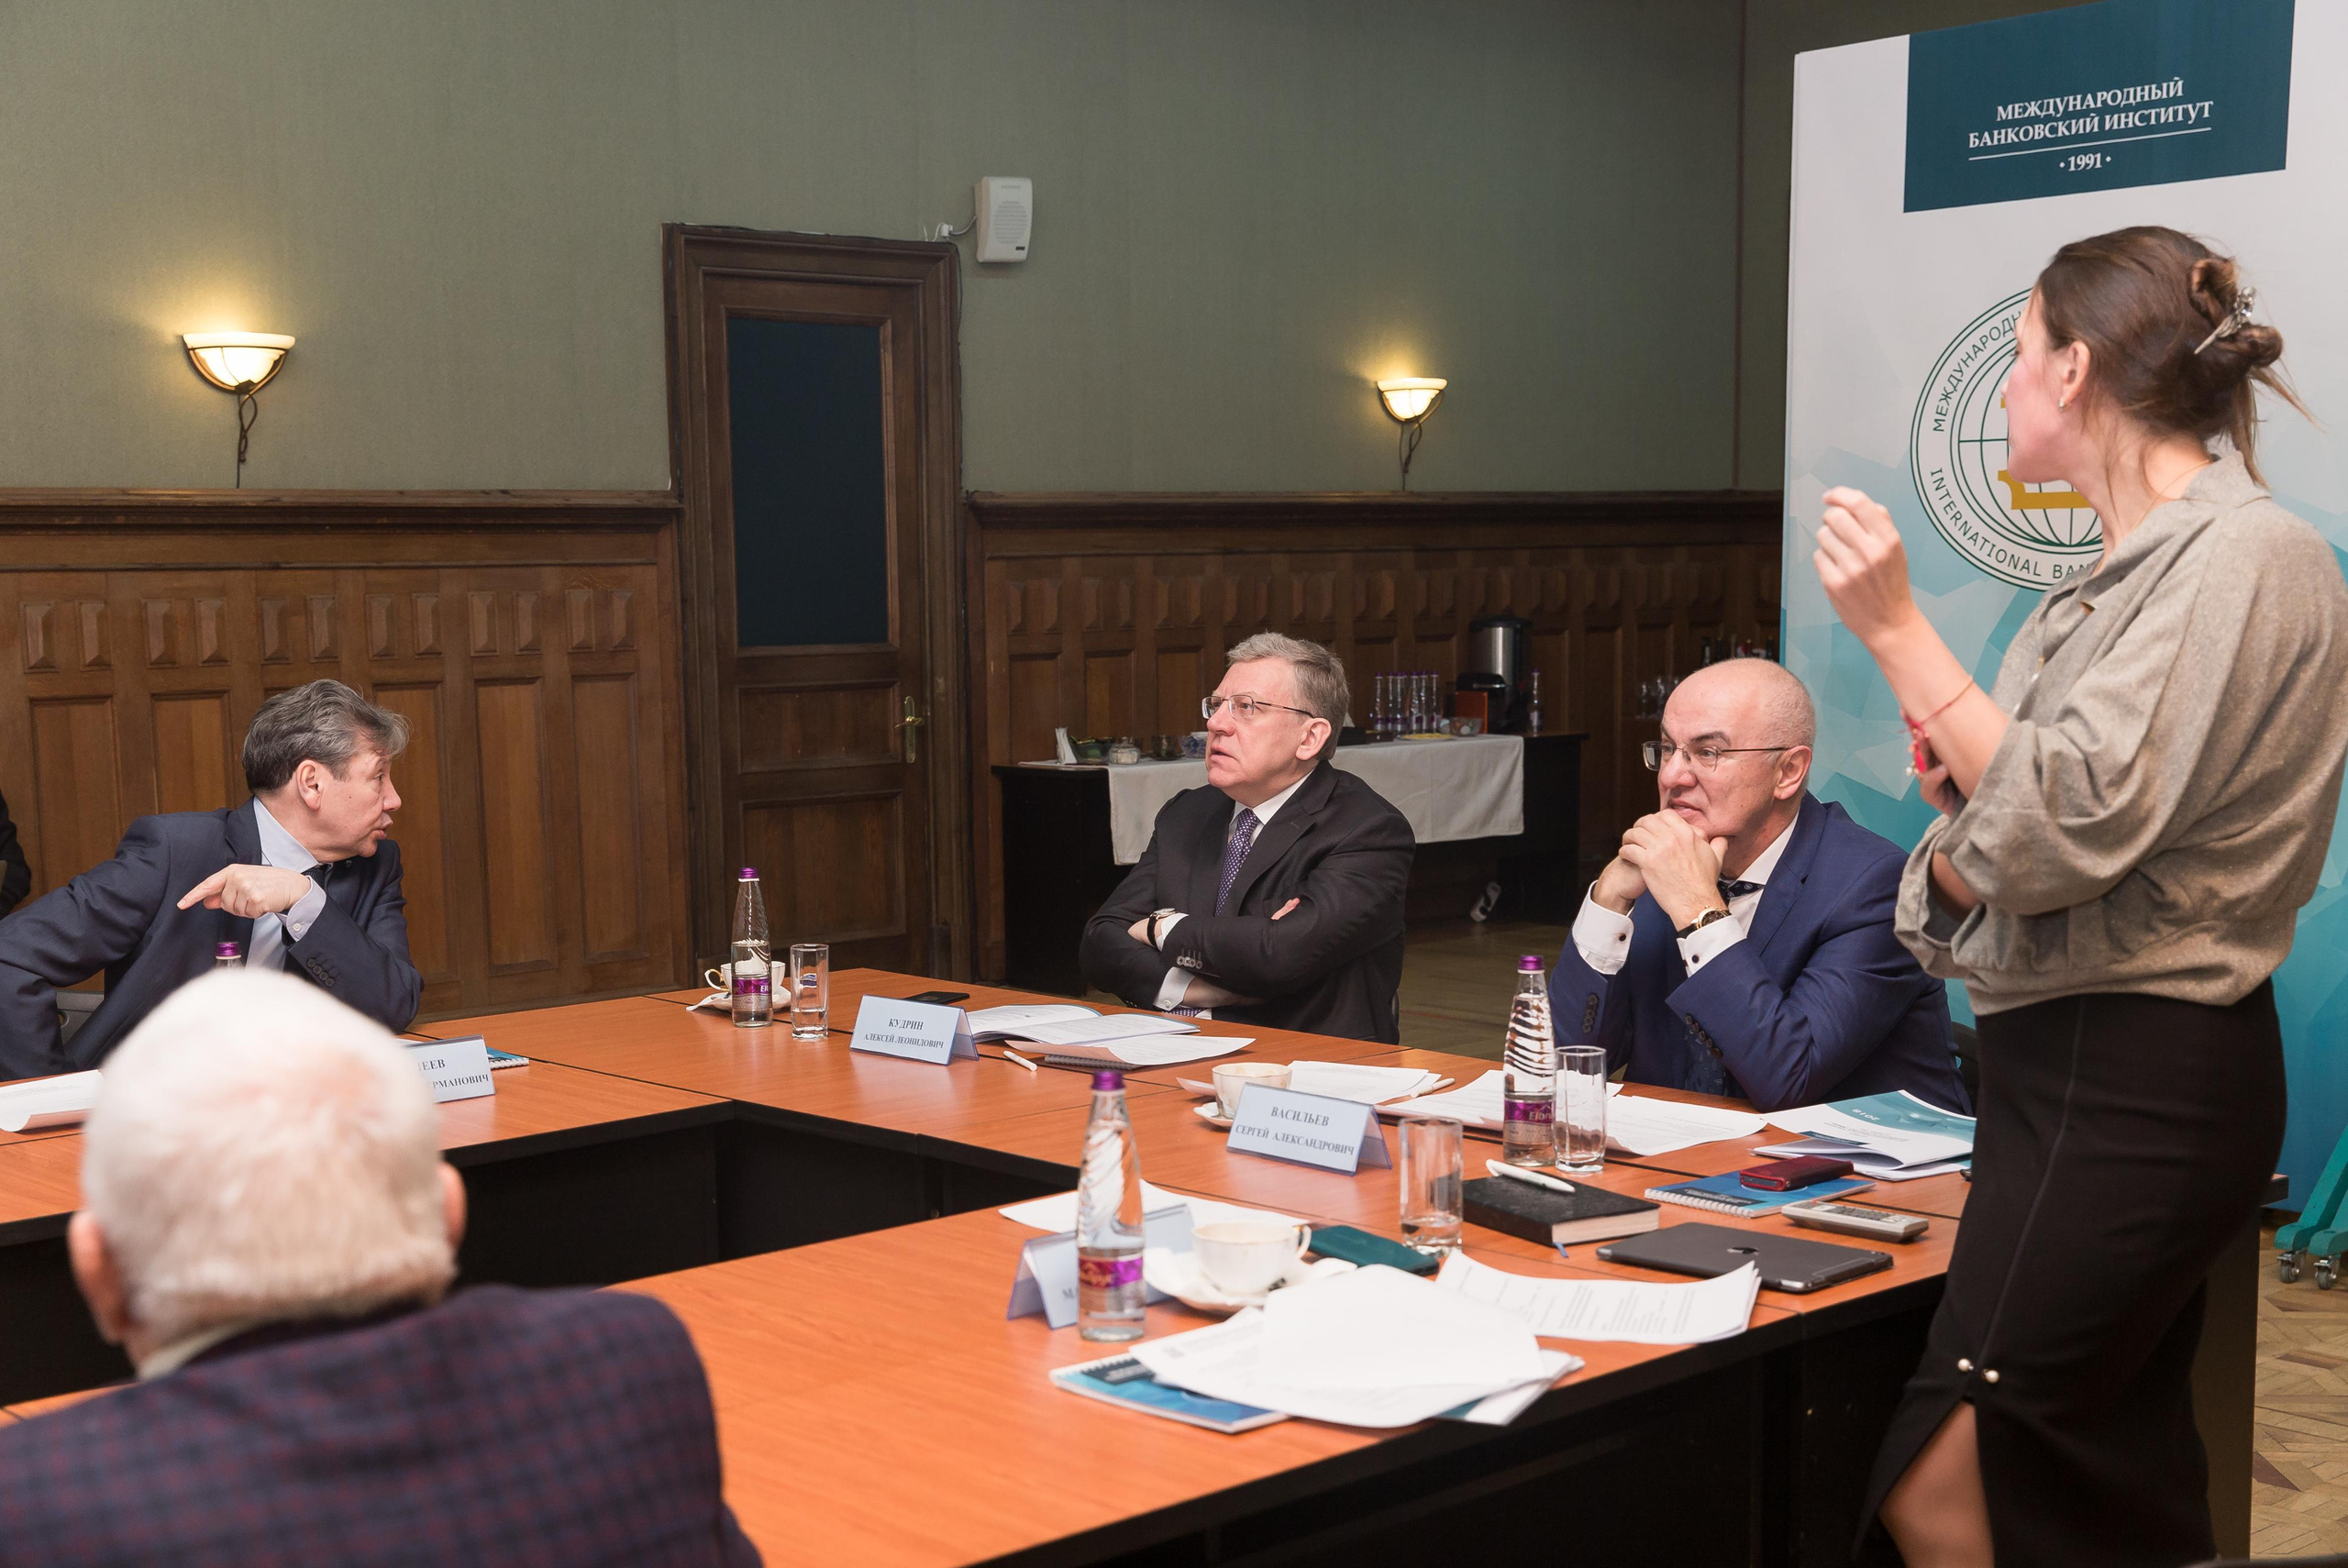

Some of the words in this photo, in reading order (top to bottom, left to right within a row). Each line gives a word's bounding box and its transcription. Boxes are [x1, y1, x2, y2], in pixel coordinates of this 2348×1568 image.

[1996, 76, 2184, 121] МЕЖДУНАРОДНЫЙ
[1968, 113, 2099, 149] БАНКОВСКИЙ
[2104, 100, 2214, 131] ИНСТИТУТ
[1933, 309, 2023, 432] МЕЖДУНАРОДН
[1931, 468, 2042, 577] INTERNATIONAL
[888, 1018, 925, 1031] КУДРИН
[863, 1032, 894, 1043] АЛЕКСЕЙ
[895, 1035, 945, 1049] ЛЕОНИДОВИЧ
[419, 1059, 446, 1072] ЕЕВ
[429, 1073, 489, 1089] РМАНОВИЧ
[1270, 1106, 1330, 1127] ВАСИЛЬЕВ
[1235, 1124, 1269, 1139] СЕРГЕЙ
[1272, 1132, 1355, 1155] АЛЕКСАНДРОВИЧ
